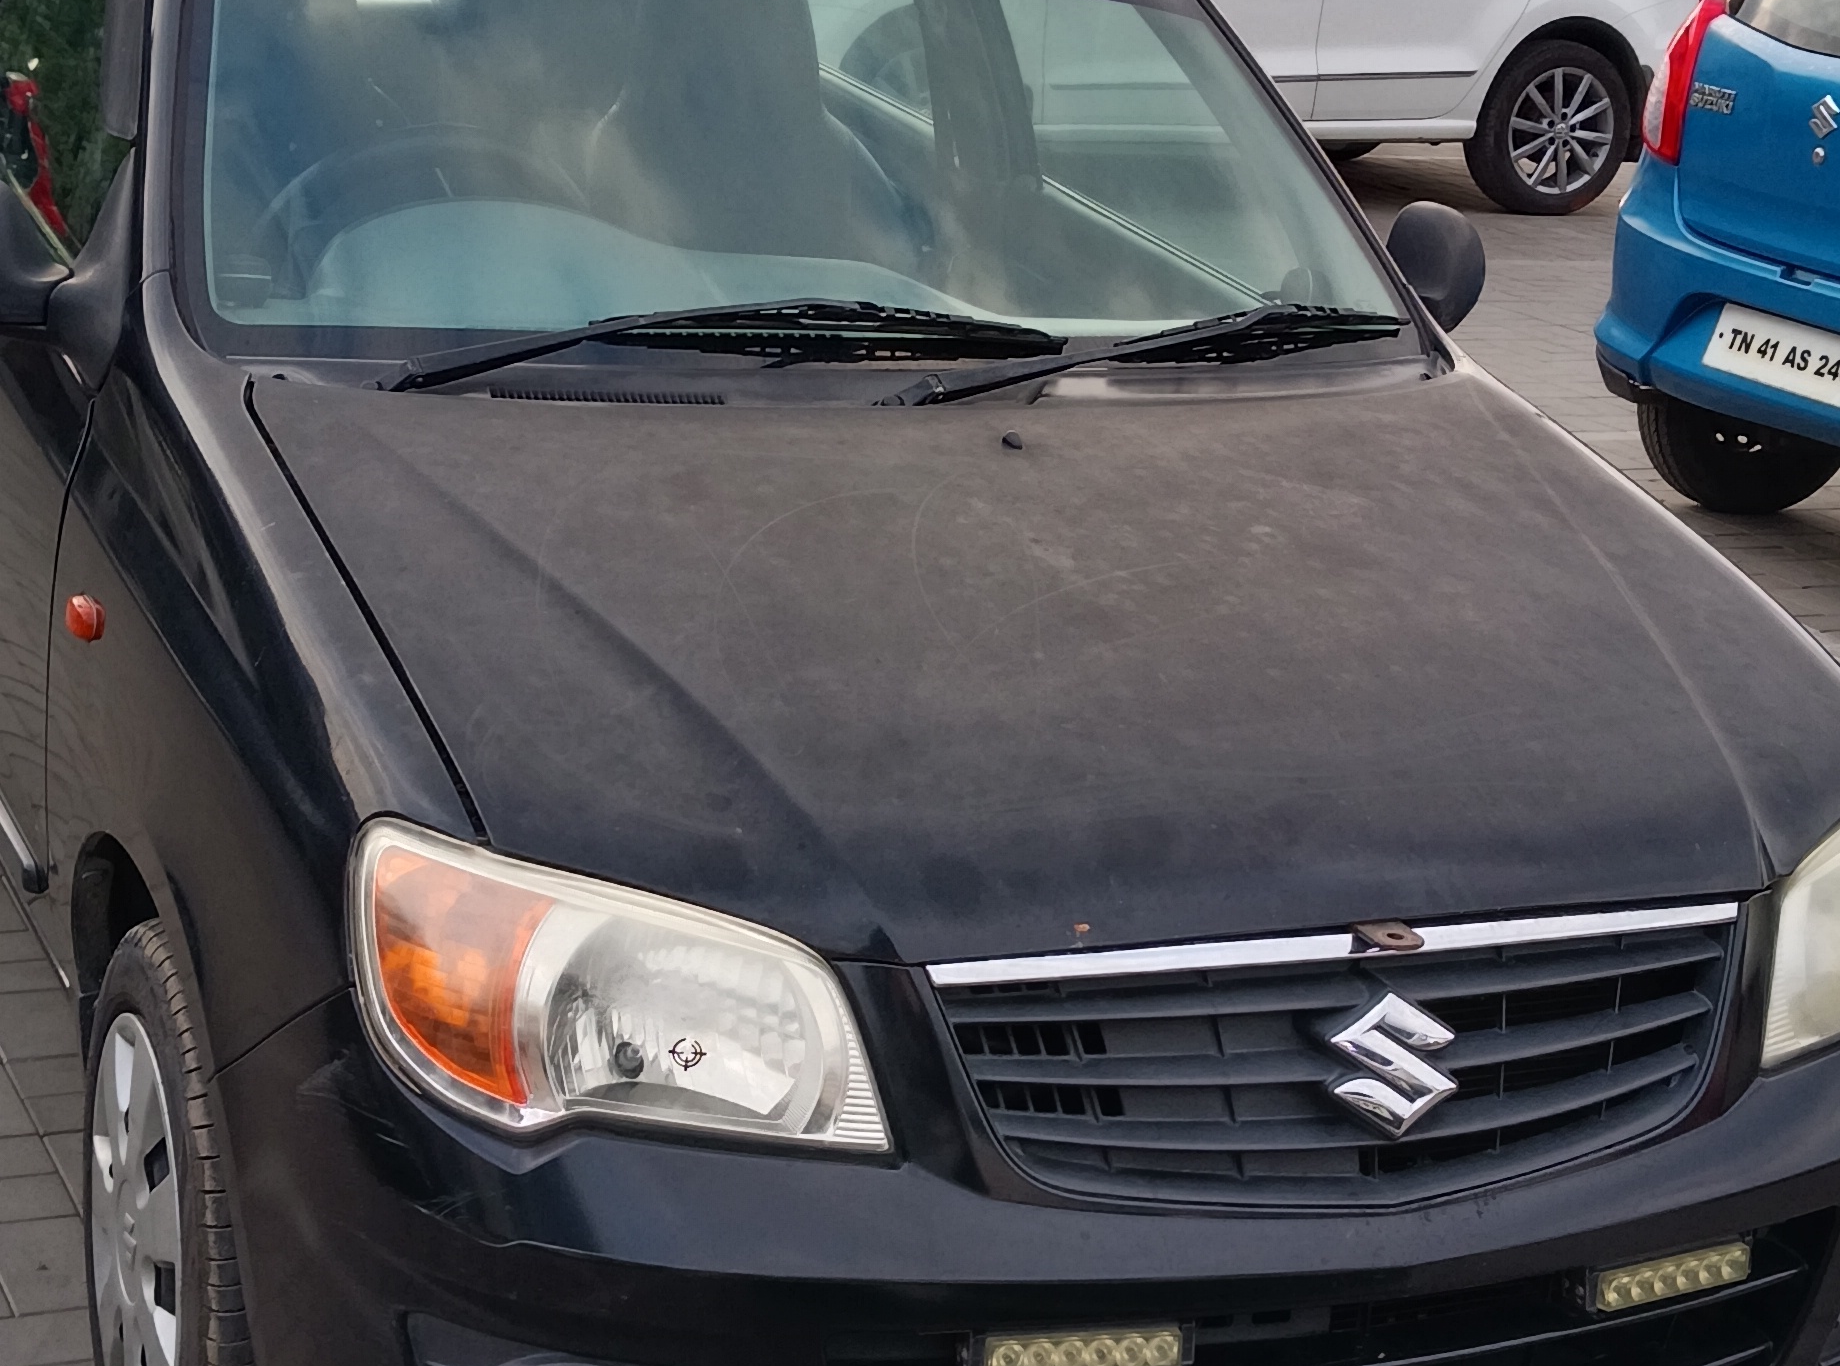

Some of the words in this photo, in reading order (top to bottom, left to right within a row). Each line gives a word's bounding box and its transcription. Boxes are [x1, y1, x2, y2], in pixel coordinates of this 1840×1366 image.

[1728, 328, 1755, 354] TN
[1757, 338, 1780, 362] 41
[1782, 346, 1811, 371] AS
